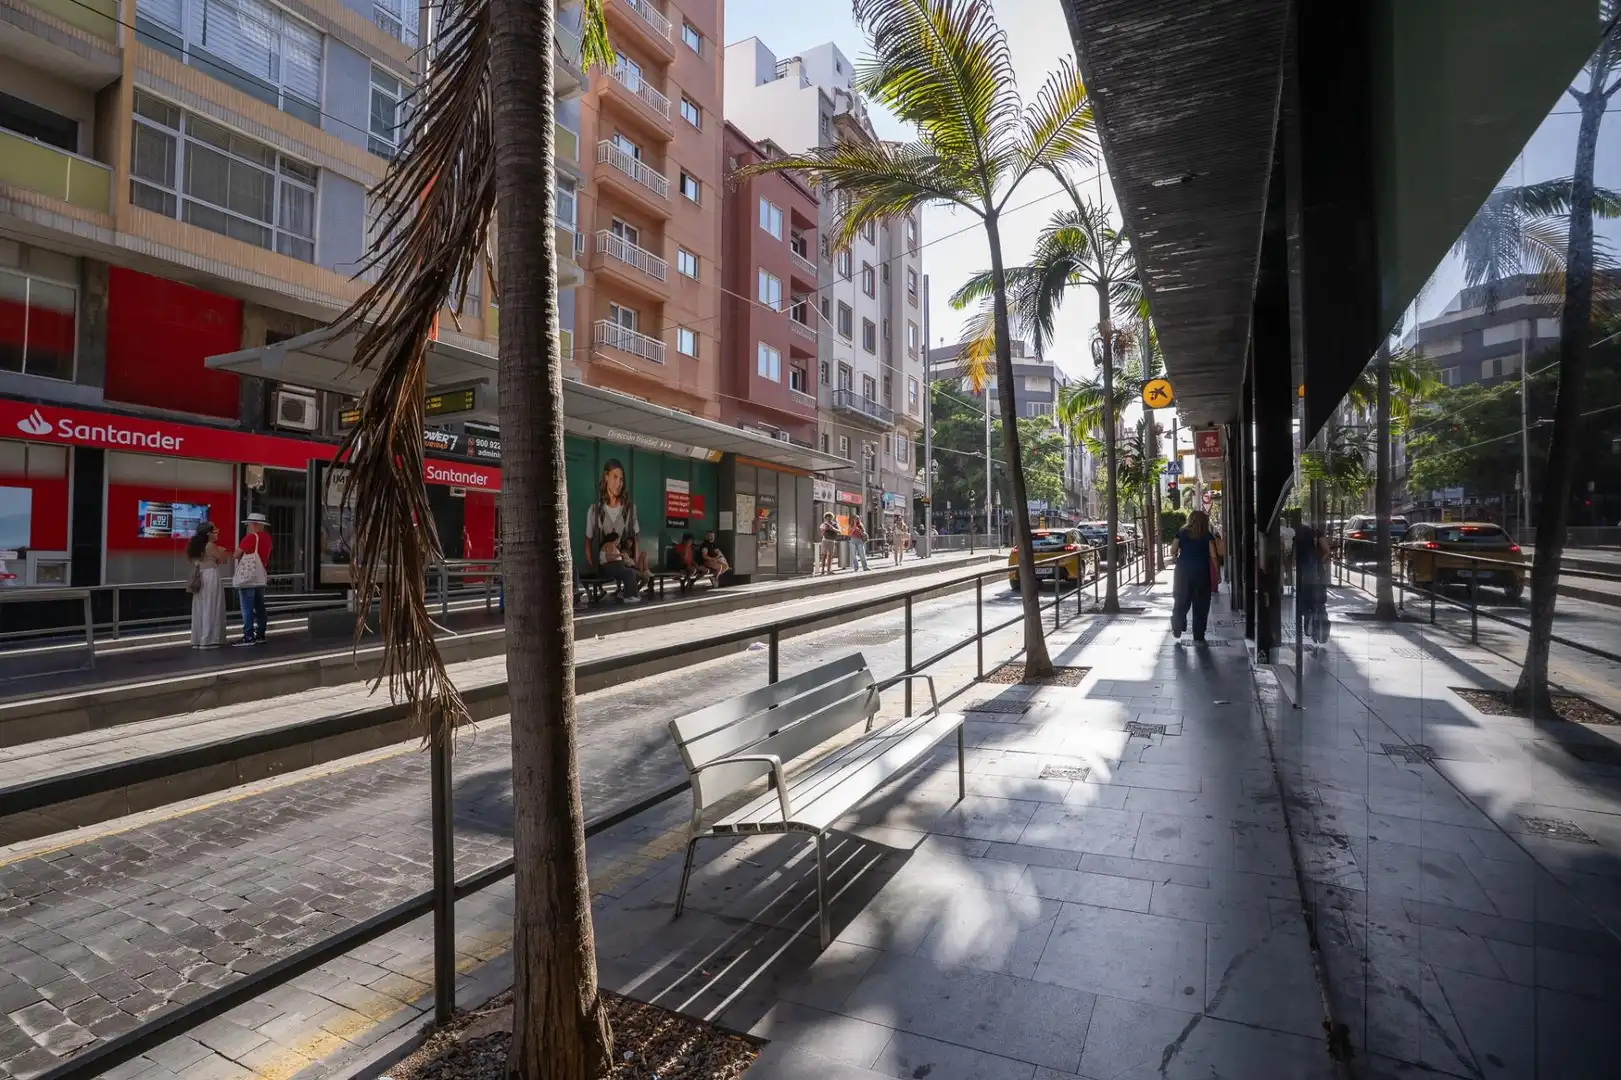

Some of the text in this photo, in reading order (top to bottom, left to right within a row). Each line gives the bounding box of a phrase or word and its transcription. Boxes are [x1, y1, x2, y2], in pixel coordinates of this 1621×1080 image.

[58, 419, 184, 450] Santander
[424, 430, 458, 451] OWER7
[424, 441, 449, 449] URIDAD
[426, 466, 489, 486] Santander
